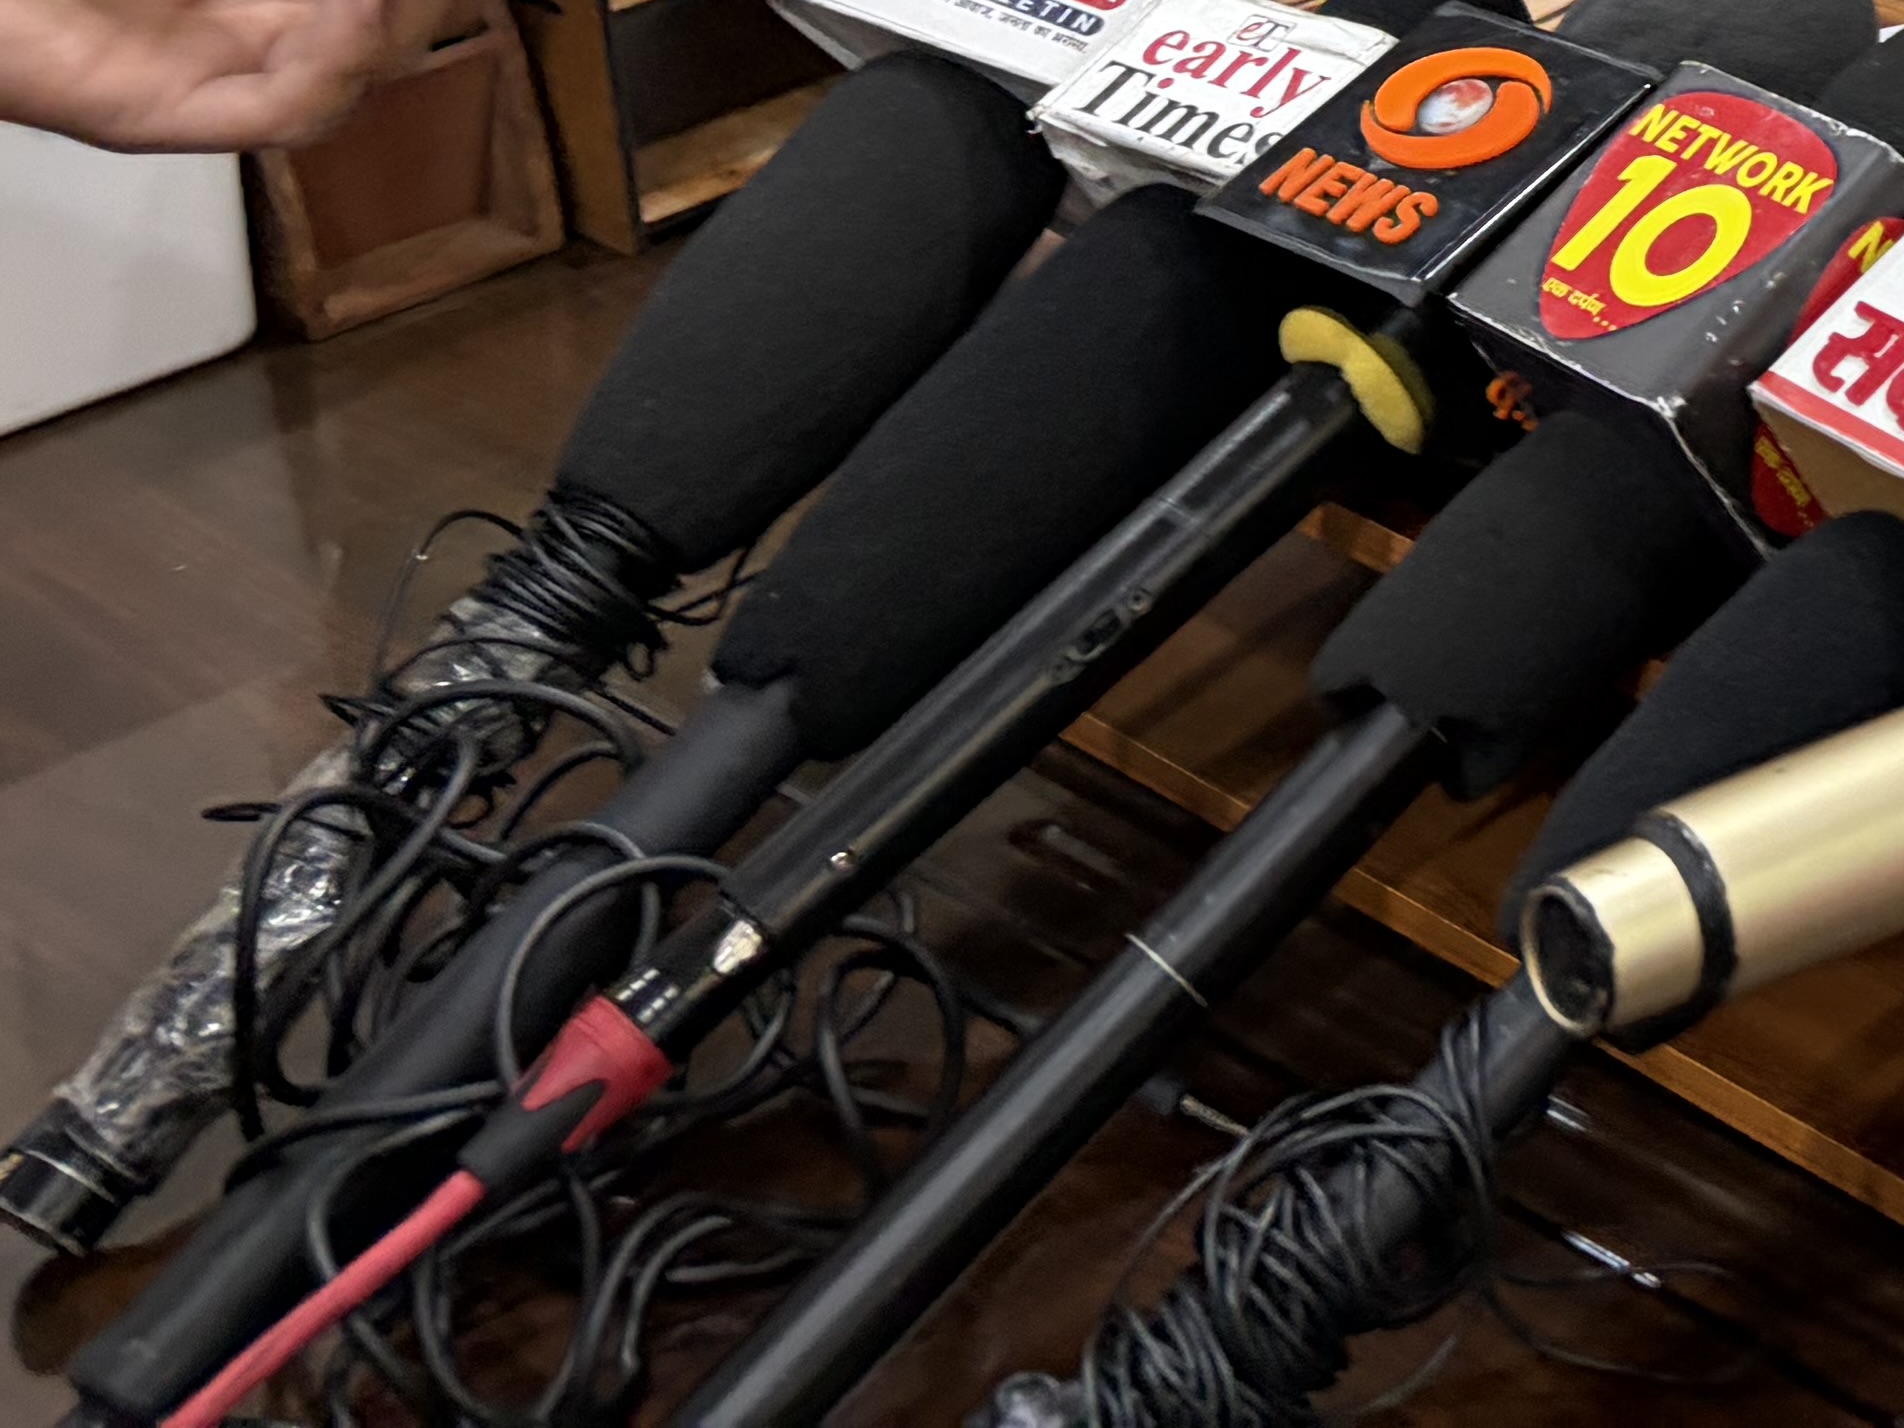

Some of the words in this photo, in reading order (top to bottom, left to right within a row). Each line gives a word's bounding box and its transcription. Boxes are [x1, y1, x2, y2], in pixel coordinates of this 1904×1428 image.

[1074, 60, 1283, 164] Times
[1141, 23, 1332, 119] early
[1258, 147, 1439, 244] NEWS
[1629, 103, 1836, 215] NETWORK
[1551, 155, 1752, 307] 10
